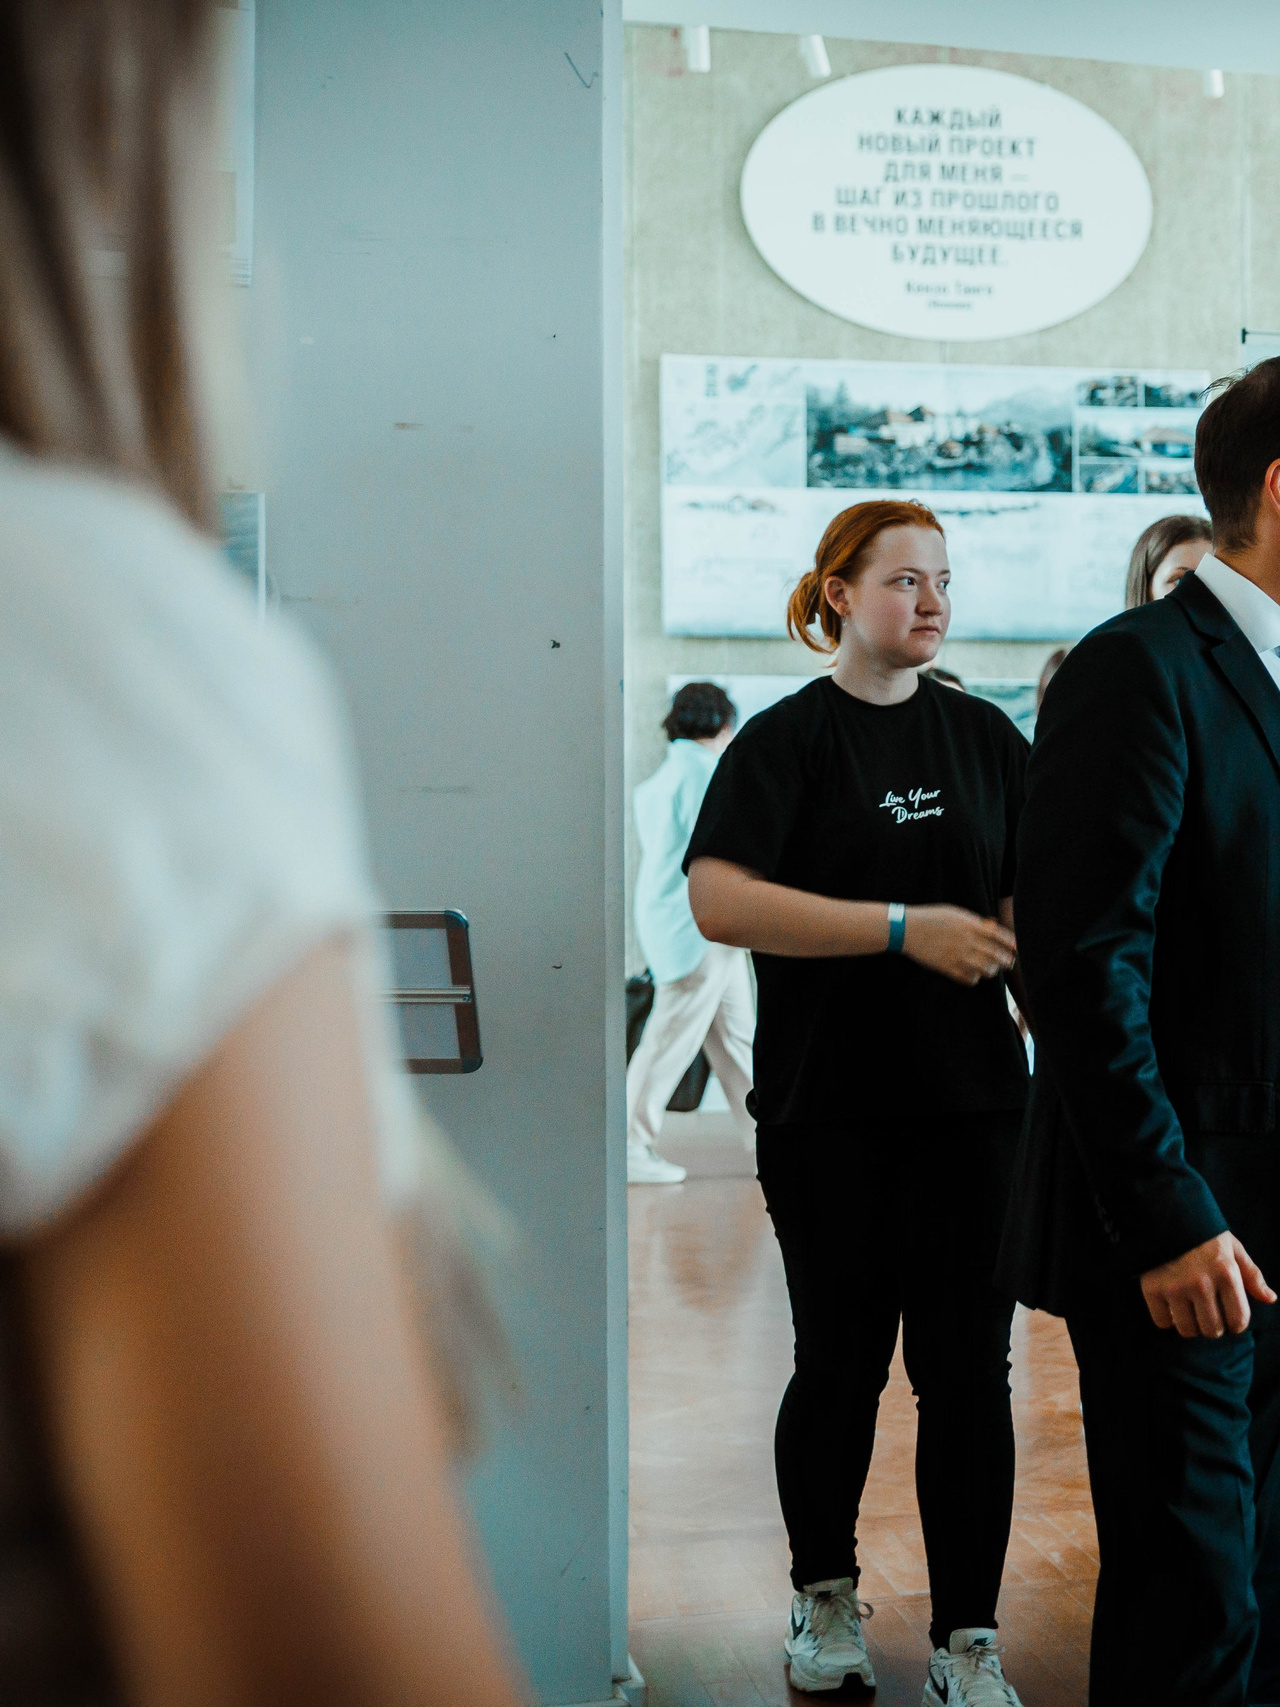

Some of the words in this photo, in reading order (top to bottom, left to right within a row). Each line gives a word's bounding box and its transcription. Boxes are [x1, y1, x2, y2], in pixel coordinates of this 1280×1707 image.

[896, 105, 1002, 130] КАЖДЫЙ
[858, 131, 940, 154] НОВЫЙ
[948, 136, 1037, 158] ПРОЕКТ
[883, 161, 931, 184] ДЛЯ
[939, 162, 1003, 184] МЕНЯ
[835, 186, 884, 206] ШАГ
[893, 189, 923, 209] ИЗ
[930, 189, 1060, 212] ПРОШЛОГО
[812, 213, 825, 233] В
[834, 213, 909, 235] ВЕЧНО
[916, 216, 1084, 240] МЕНЯЮЩЕЕСЯ
[892, 244, 1007, 266] БУДУЩЕЕ.
[878, 790, 906, 808] Live
[908, 787, 941, 809] Your
[890, 806, 945, 824] Dreams
